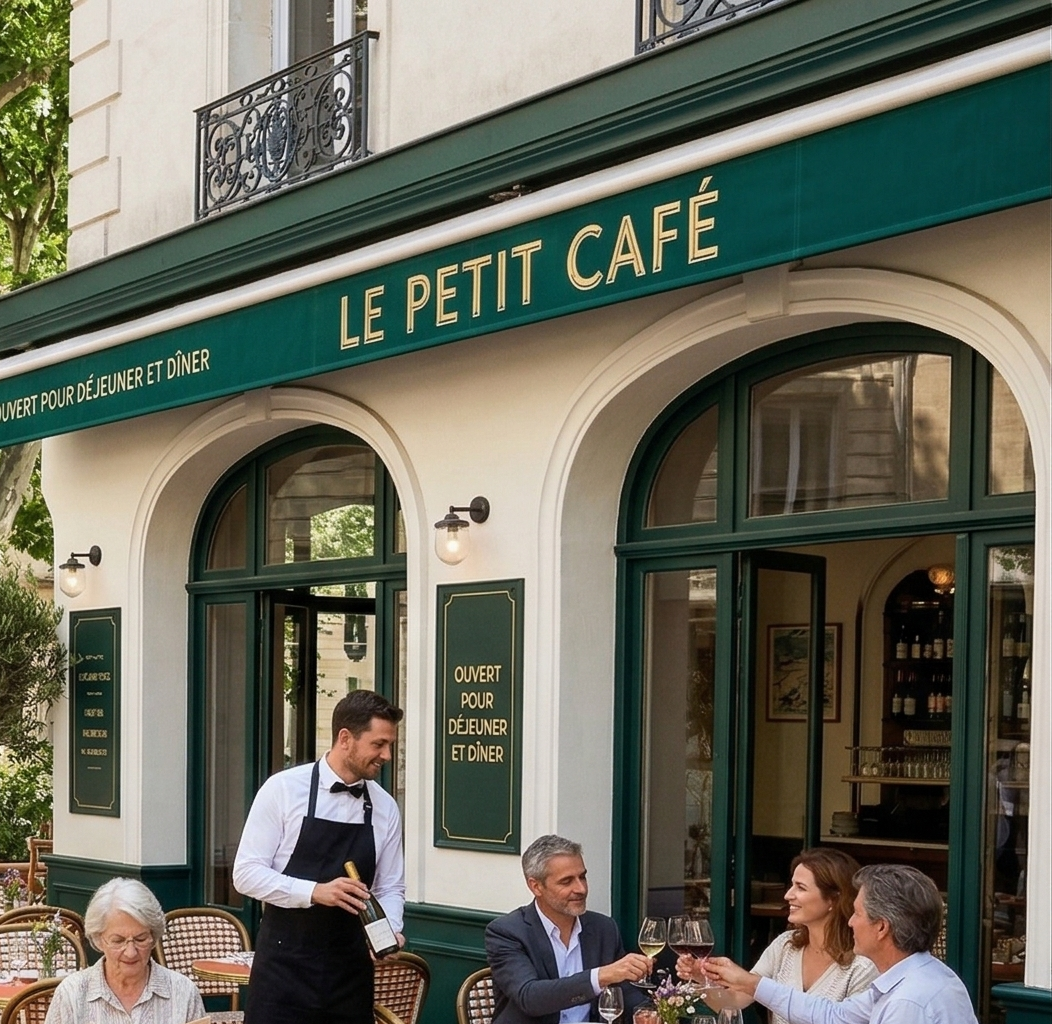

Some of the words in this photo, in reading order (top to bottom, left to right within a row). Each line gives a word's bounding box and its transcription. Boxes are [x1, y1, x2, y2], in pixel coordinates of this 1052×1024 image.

[339, 284, 385, 350] LE
[406, 239, 543, 334] PETIT
[565, 175, 719, 291] CAFÉ
[40, 385, 75, 413] POUR
[77, 366, 144, 404] DÉJEUNER
[147, 360, 164, 386] ET
[167, 348, 211, 380] DÎNER
[454, 665, 502, 683] OUVERT
[461, 692, 494, 709] POUR
[448, 713, 508, 736] DÉJEUNER
[451, 744, 466, 762] ET
[468, 740, 504, 763] DÎNER
